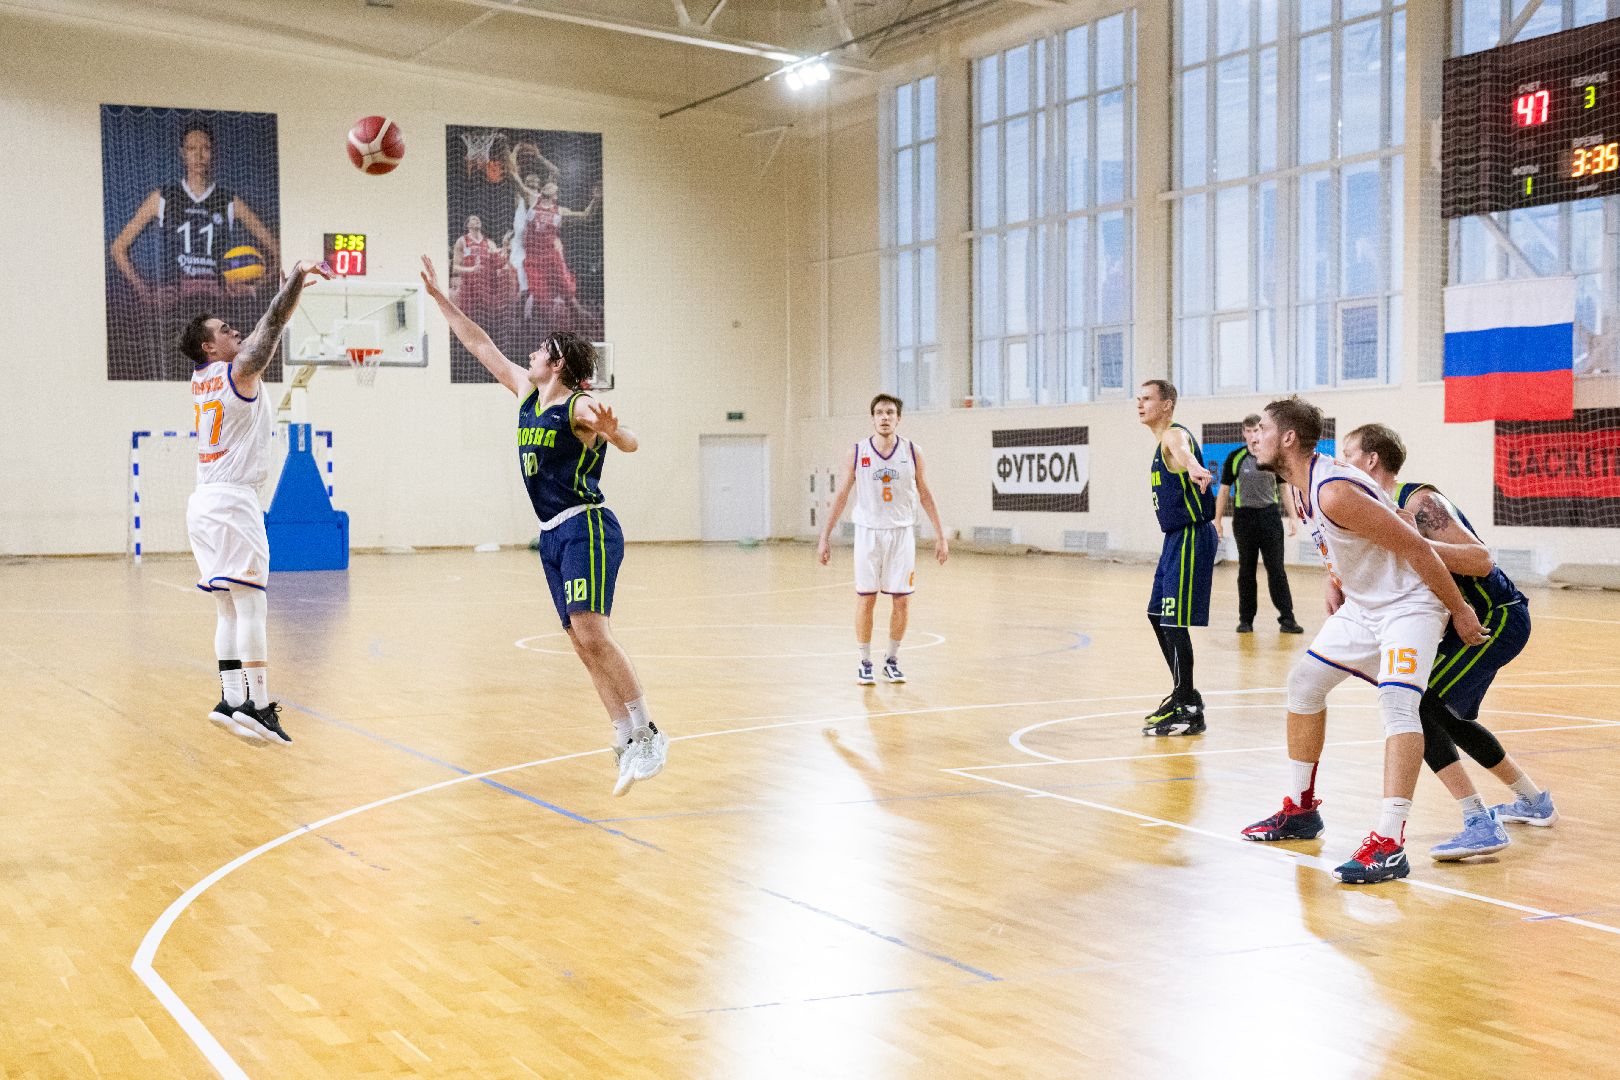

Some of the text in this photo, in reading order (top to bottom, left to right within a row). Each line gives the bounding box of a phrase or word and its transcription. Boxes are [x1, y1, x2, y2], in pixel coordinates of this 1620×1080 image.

[1517, 90, 1549, 125] 47
[1584, 85, 1596, 109] 3
[1571, 142, 1619, 178] 3:35
[1525, 176, 1533, 195] 1
[177, 221, 214, 256] 11
[334, 234, 365, 251] 3:35
[336, 250, 362, 274] 07
[997, 452, 1080, 483] ФУТБОЛ
[882, 487, 893, 503] 6
[1388, 648, 1418, 676] 15
